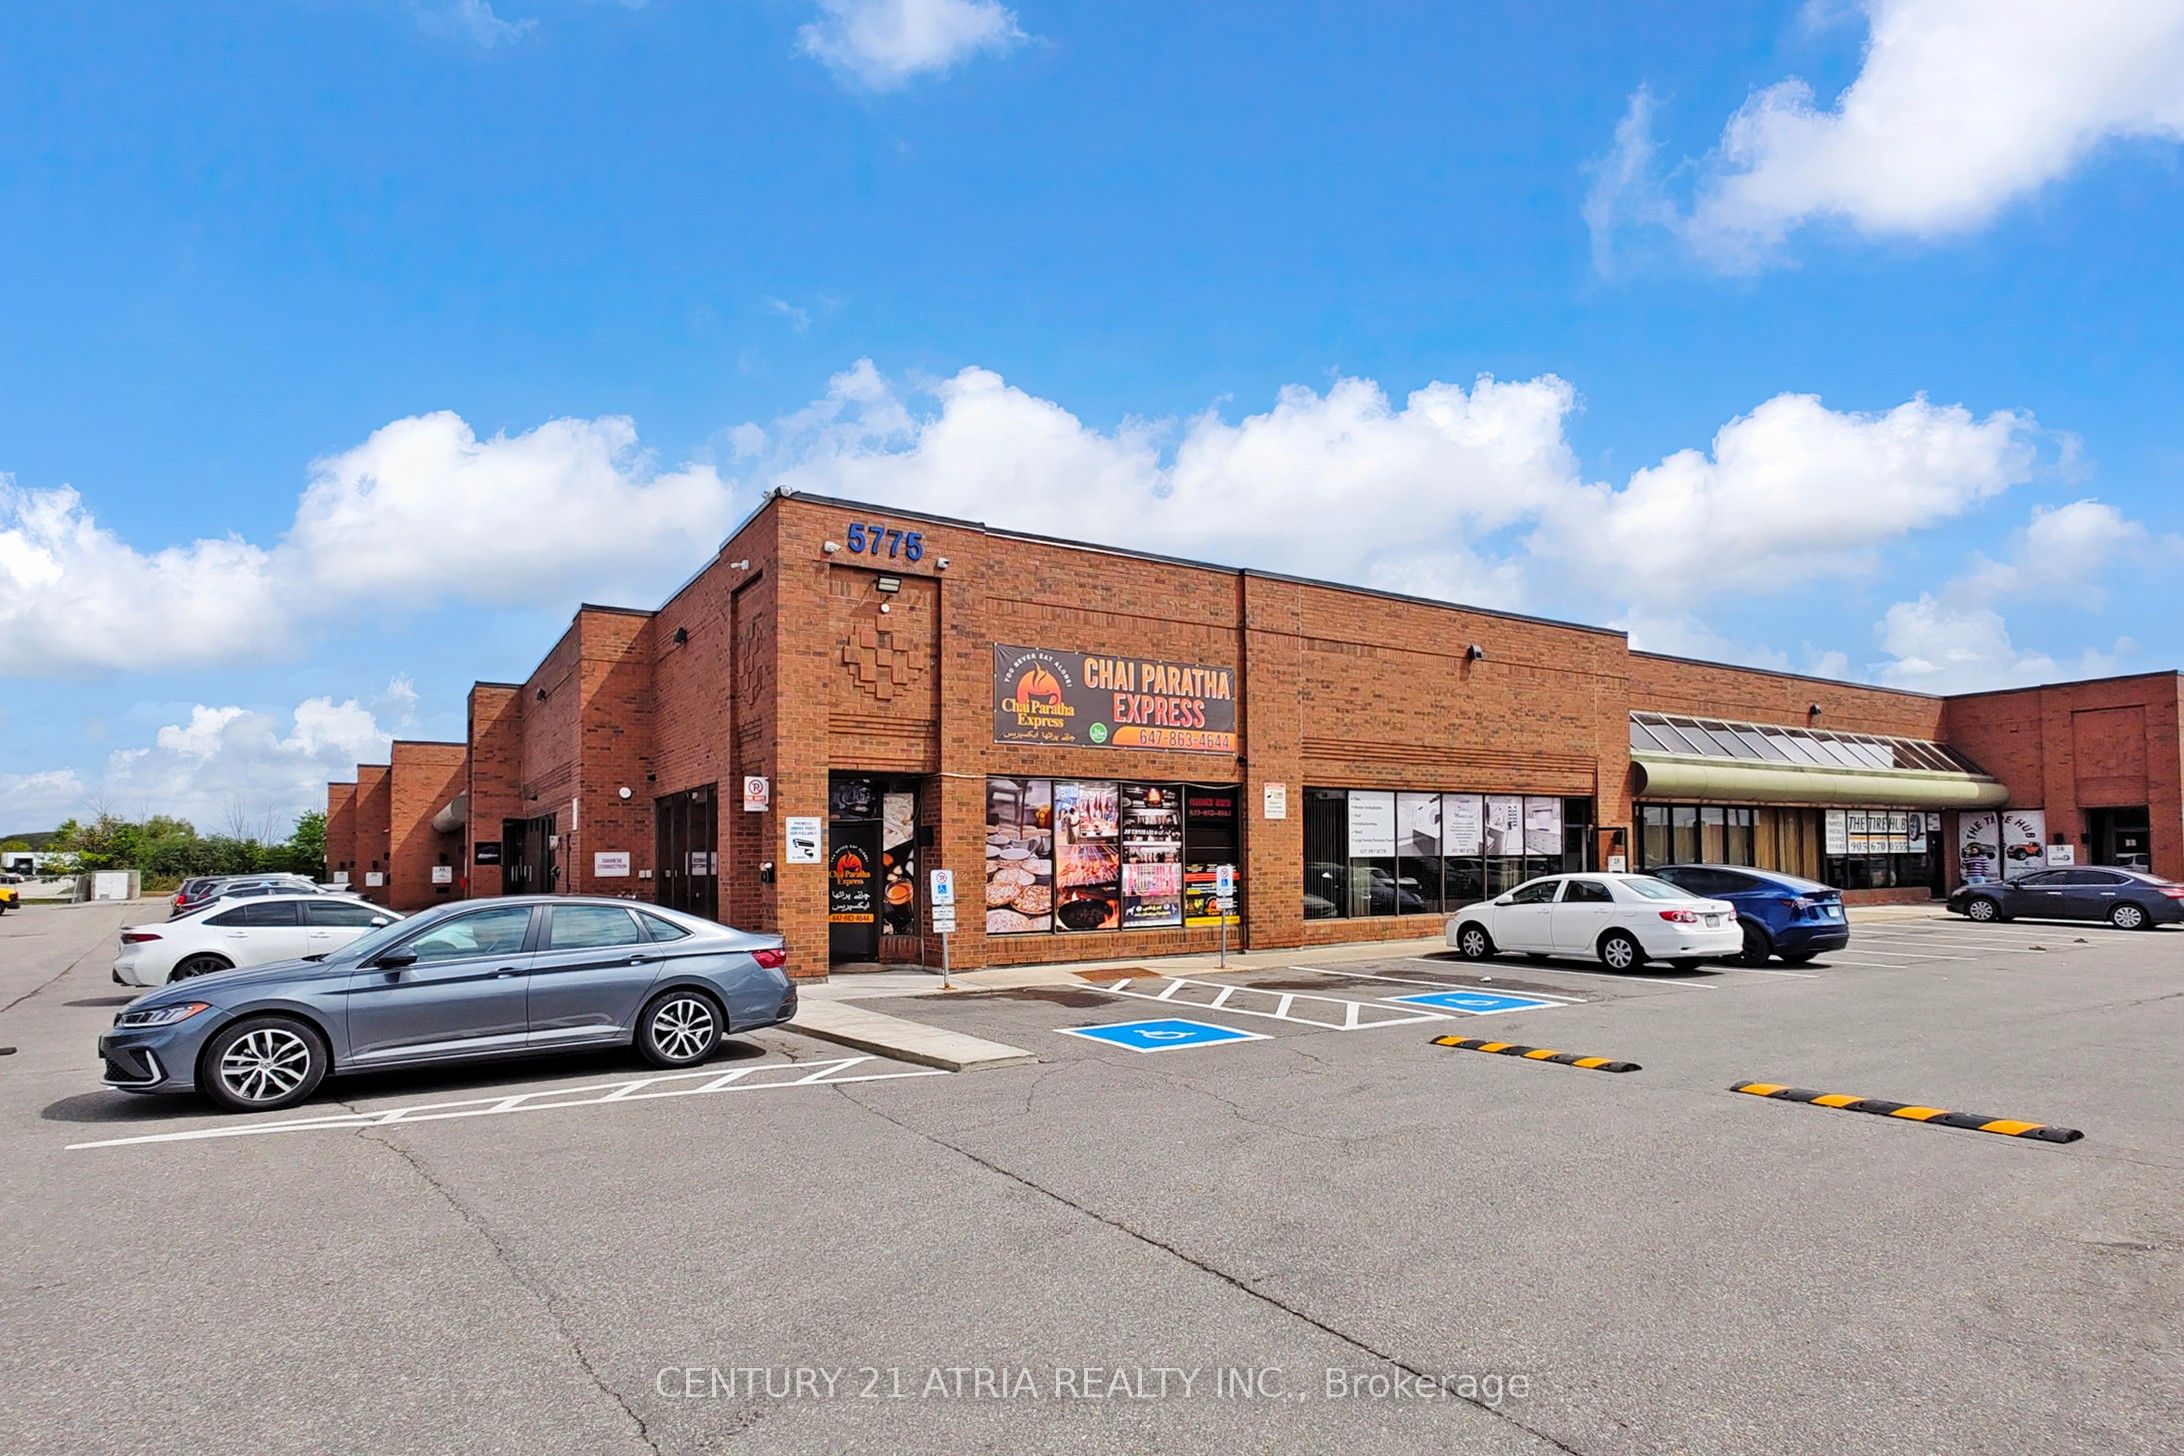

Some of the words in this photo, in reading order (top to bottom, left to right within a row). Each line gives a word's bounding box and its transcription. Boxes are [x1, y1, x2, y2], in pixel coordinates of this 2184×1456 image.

[847, 523, 923, 562] 5775
[1014, 653, 1037, 668] NEVER
[1039, 653, 1054, 663] EAT
[1084, 657, 1135, 692] CHAI
[1142, 663, 1231, 700] PARATHA
[1002, 697, 1030, 713] Chai
[1031, 699, 1075, 716] Paratha
[1113, 692, 1206, 729] EXPRESS
[1017, 713, 1065, 729] Express
[1140, 729, 1230, 749] 647-863-4644
[1849, 816, 1865, 831] THE
[1868, 816, 1887, 831] TIRE
[1888, 816, 1906, 830] HUB
[1966, 821, 1983, 840] THE
[2014, 819, 2036, 839] HUB
[1850, 841, 1867, 851] 905
[1870, 841, 1886, 851] 670
